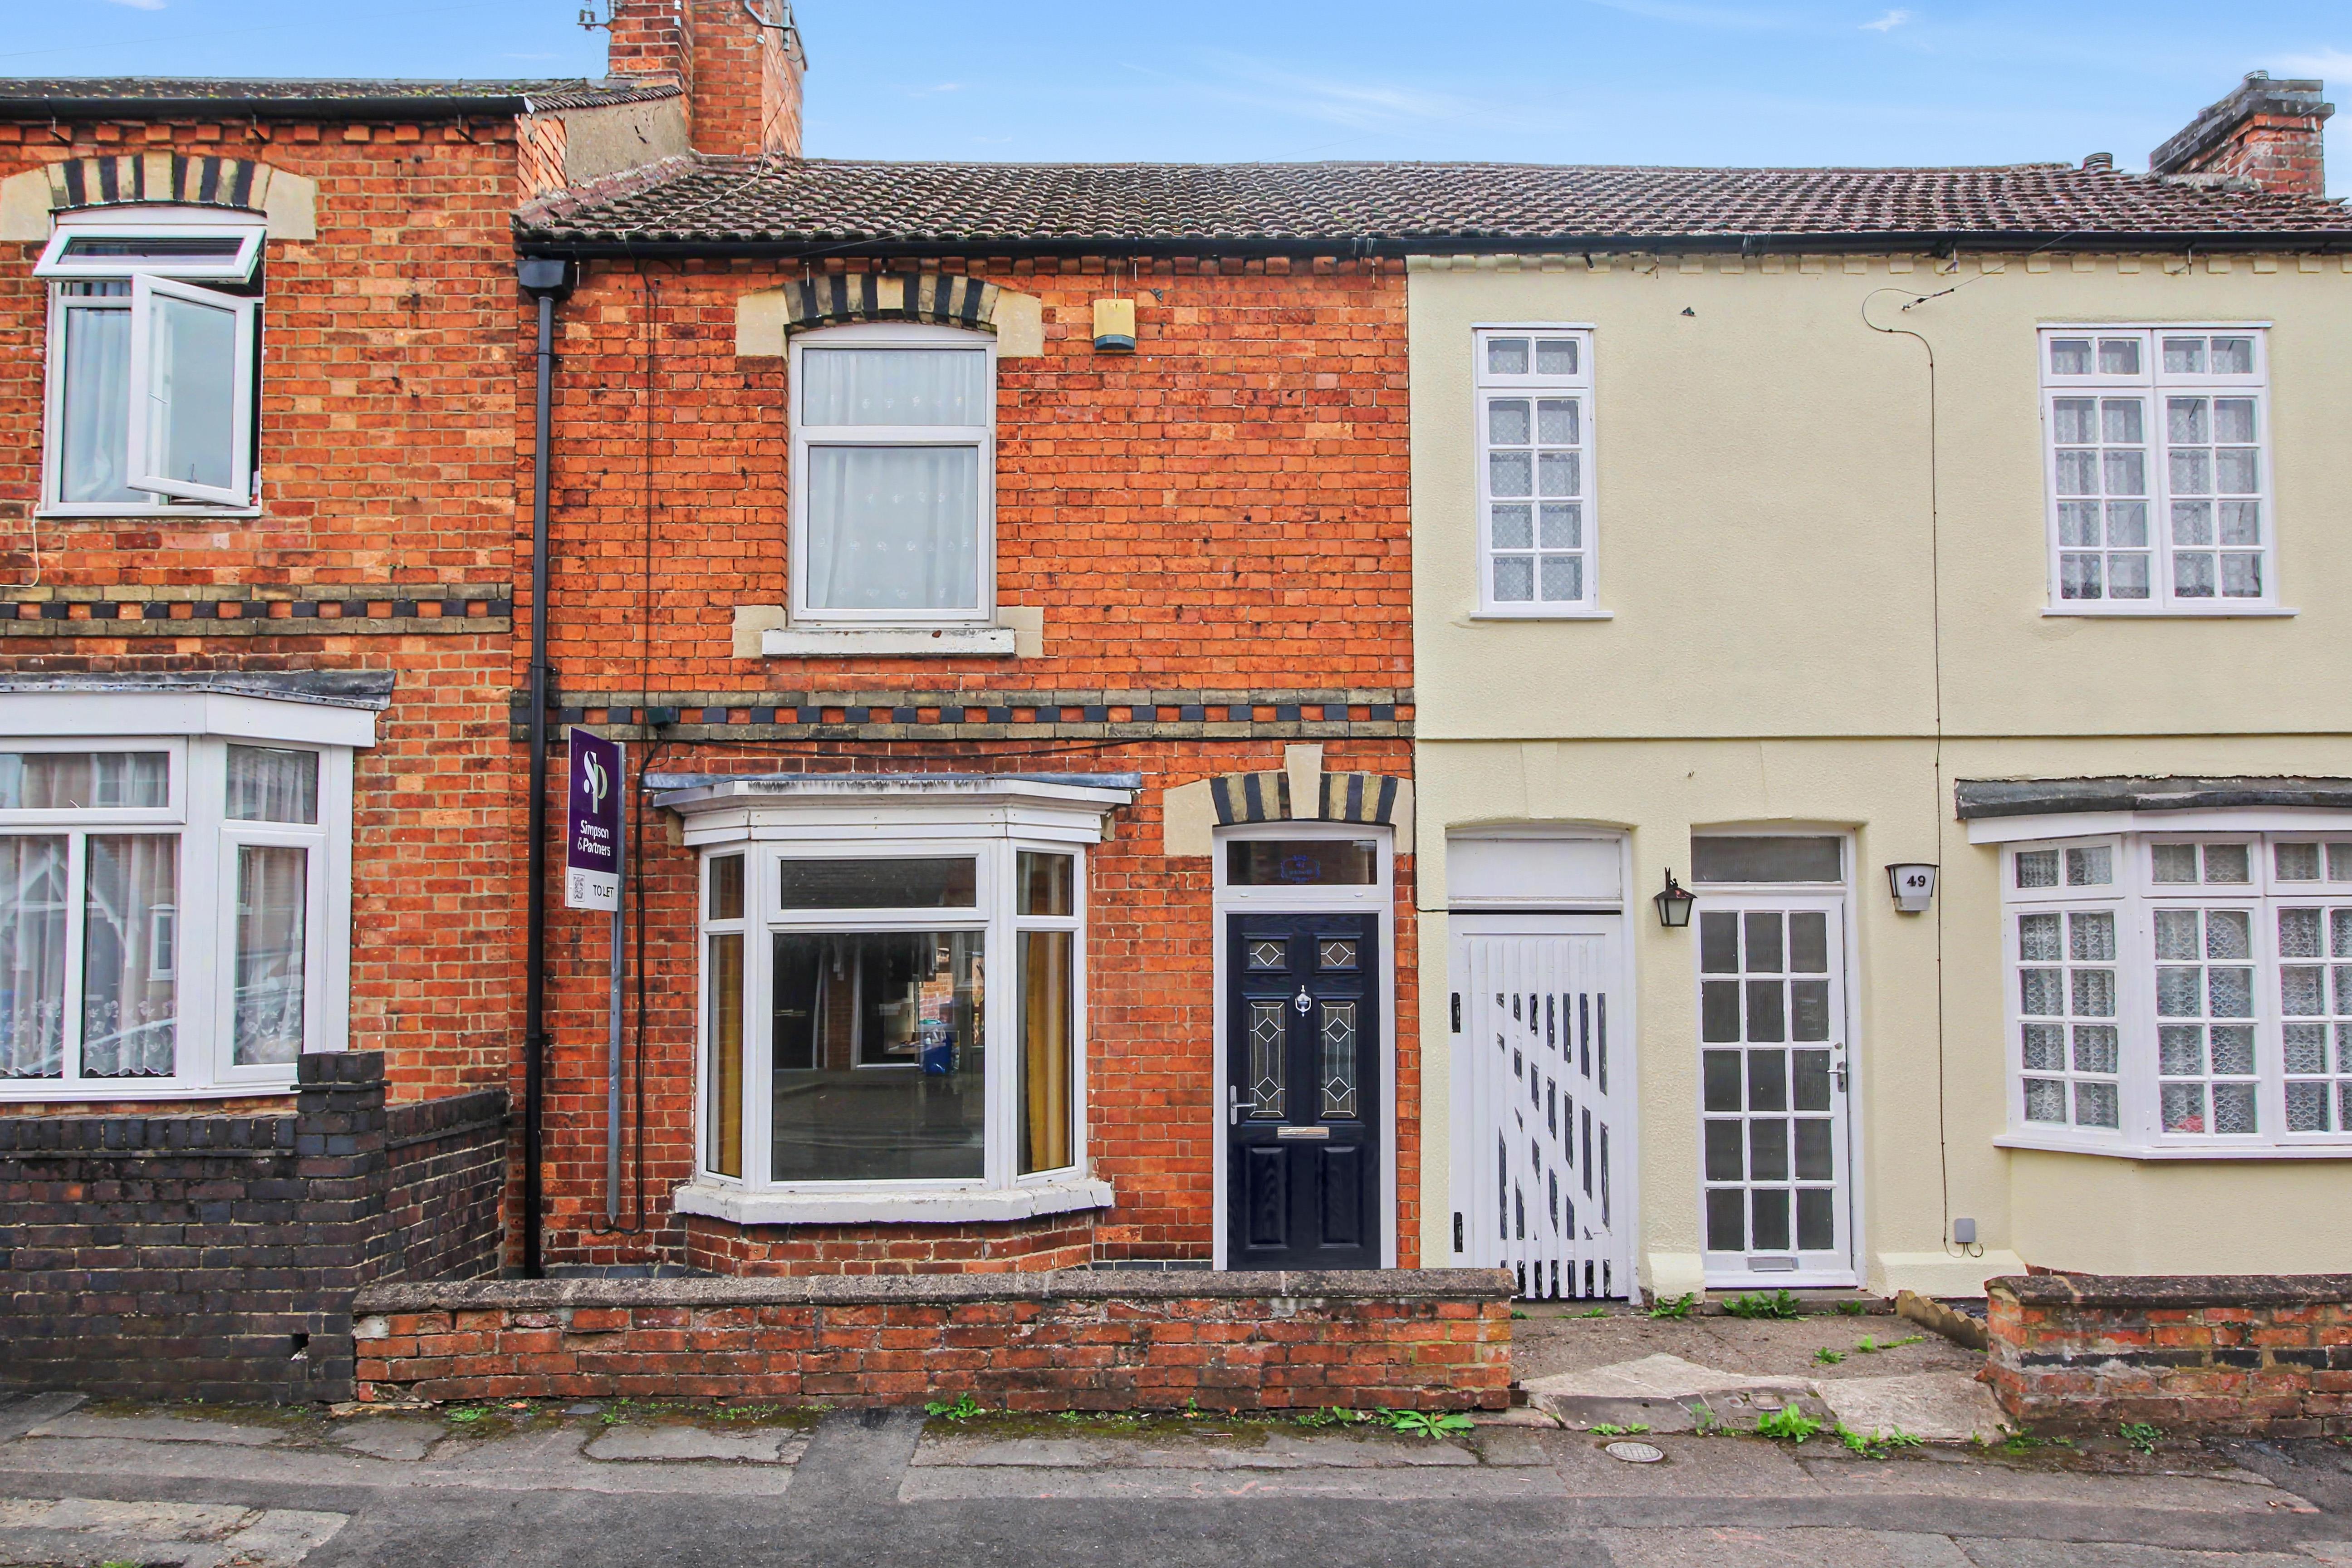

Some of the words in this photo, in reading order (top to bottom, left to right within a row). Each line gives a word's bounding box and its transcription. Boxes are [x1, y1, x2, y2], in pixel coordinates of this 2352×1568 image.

[580, 819, 609, 840] Simpson
[1906, 875, 1926, 887] 49
[593, 885, 602, 896] TO
[603, 886, 614, 898] LET
